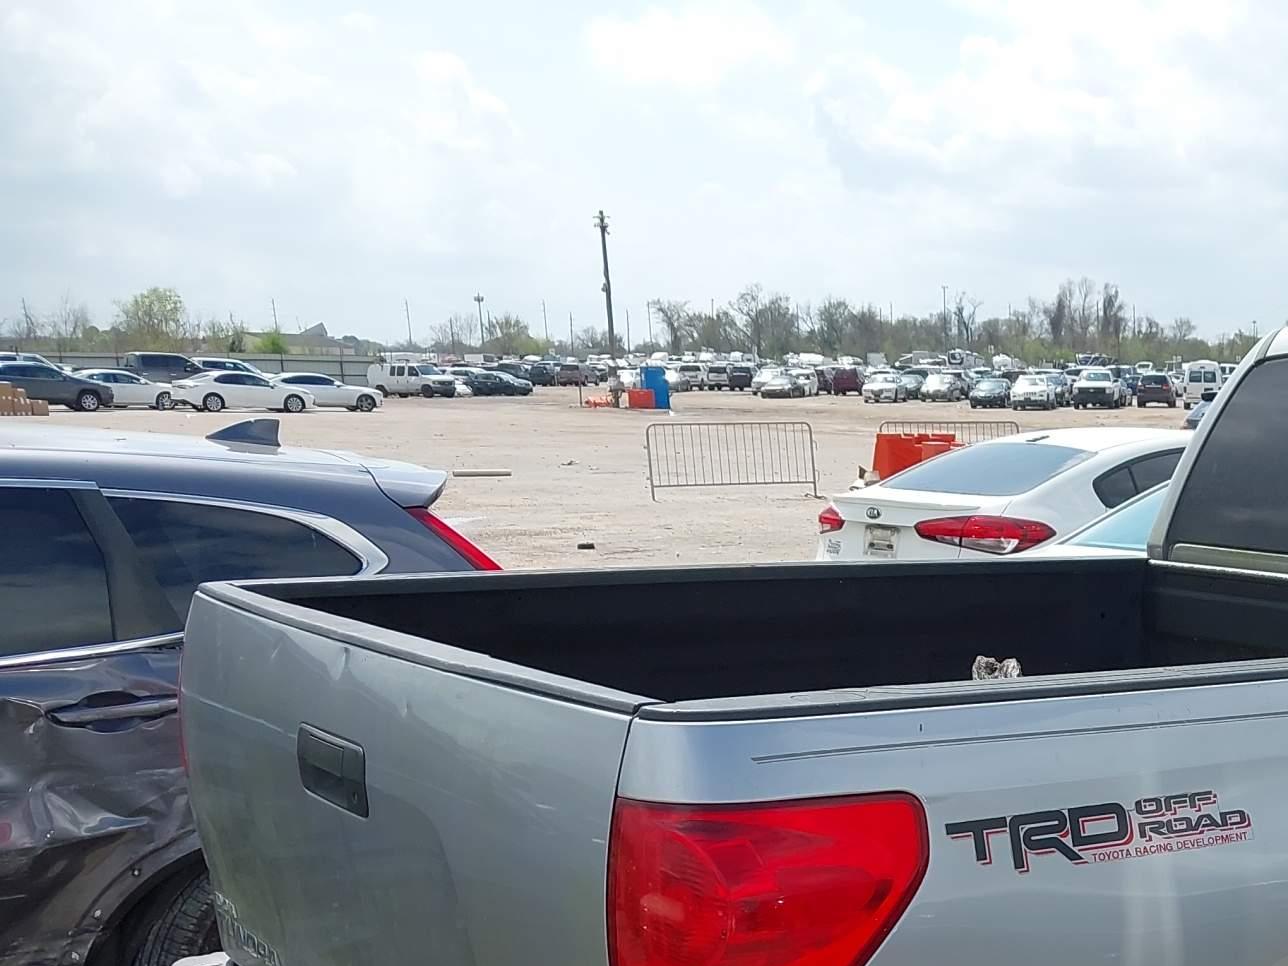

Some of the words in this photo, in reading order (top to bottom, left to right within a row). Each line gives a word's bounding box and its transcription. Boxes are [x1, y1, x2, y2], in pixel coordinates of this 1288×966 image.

[1134, 790, 1217, 818] OFF
[945, 802, 1133, 873] TRD
[1137, 810, 1252, 842] ROAD
[1092, 848, 1132, 863] TOYOTA
[1136, 842, 1174, 857] RACING
[1176, 831, 1248, 849] DEVELOPMENT
